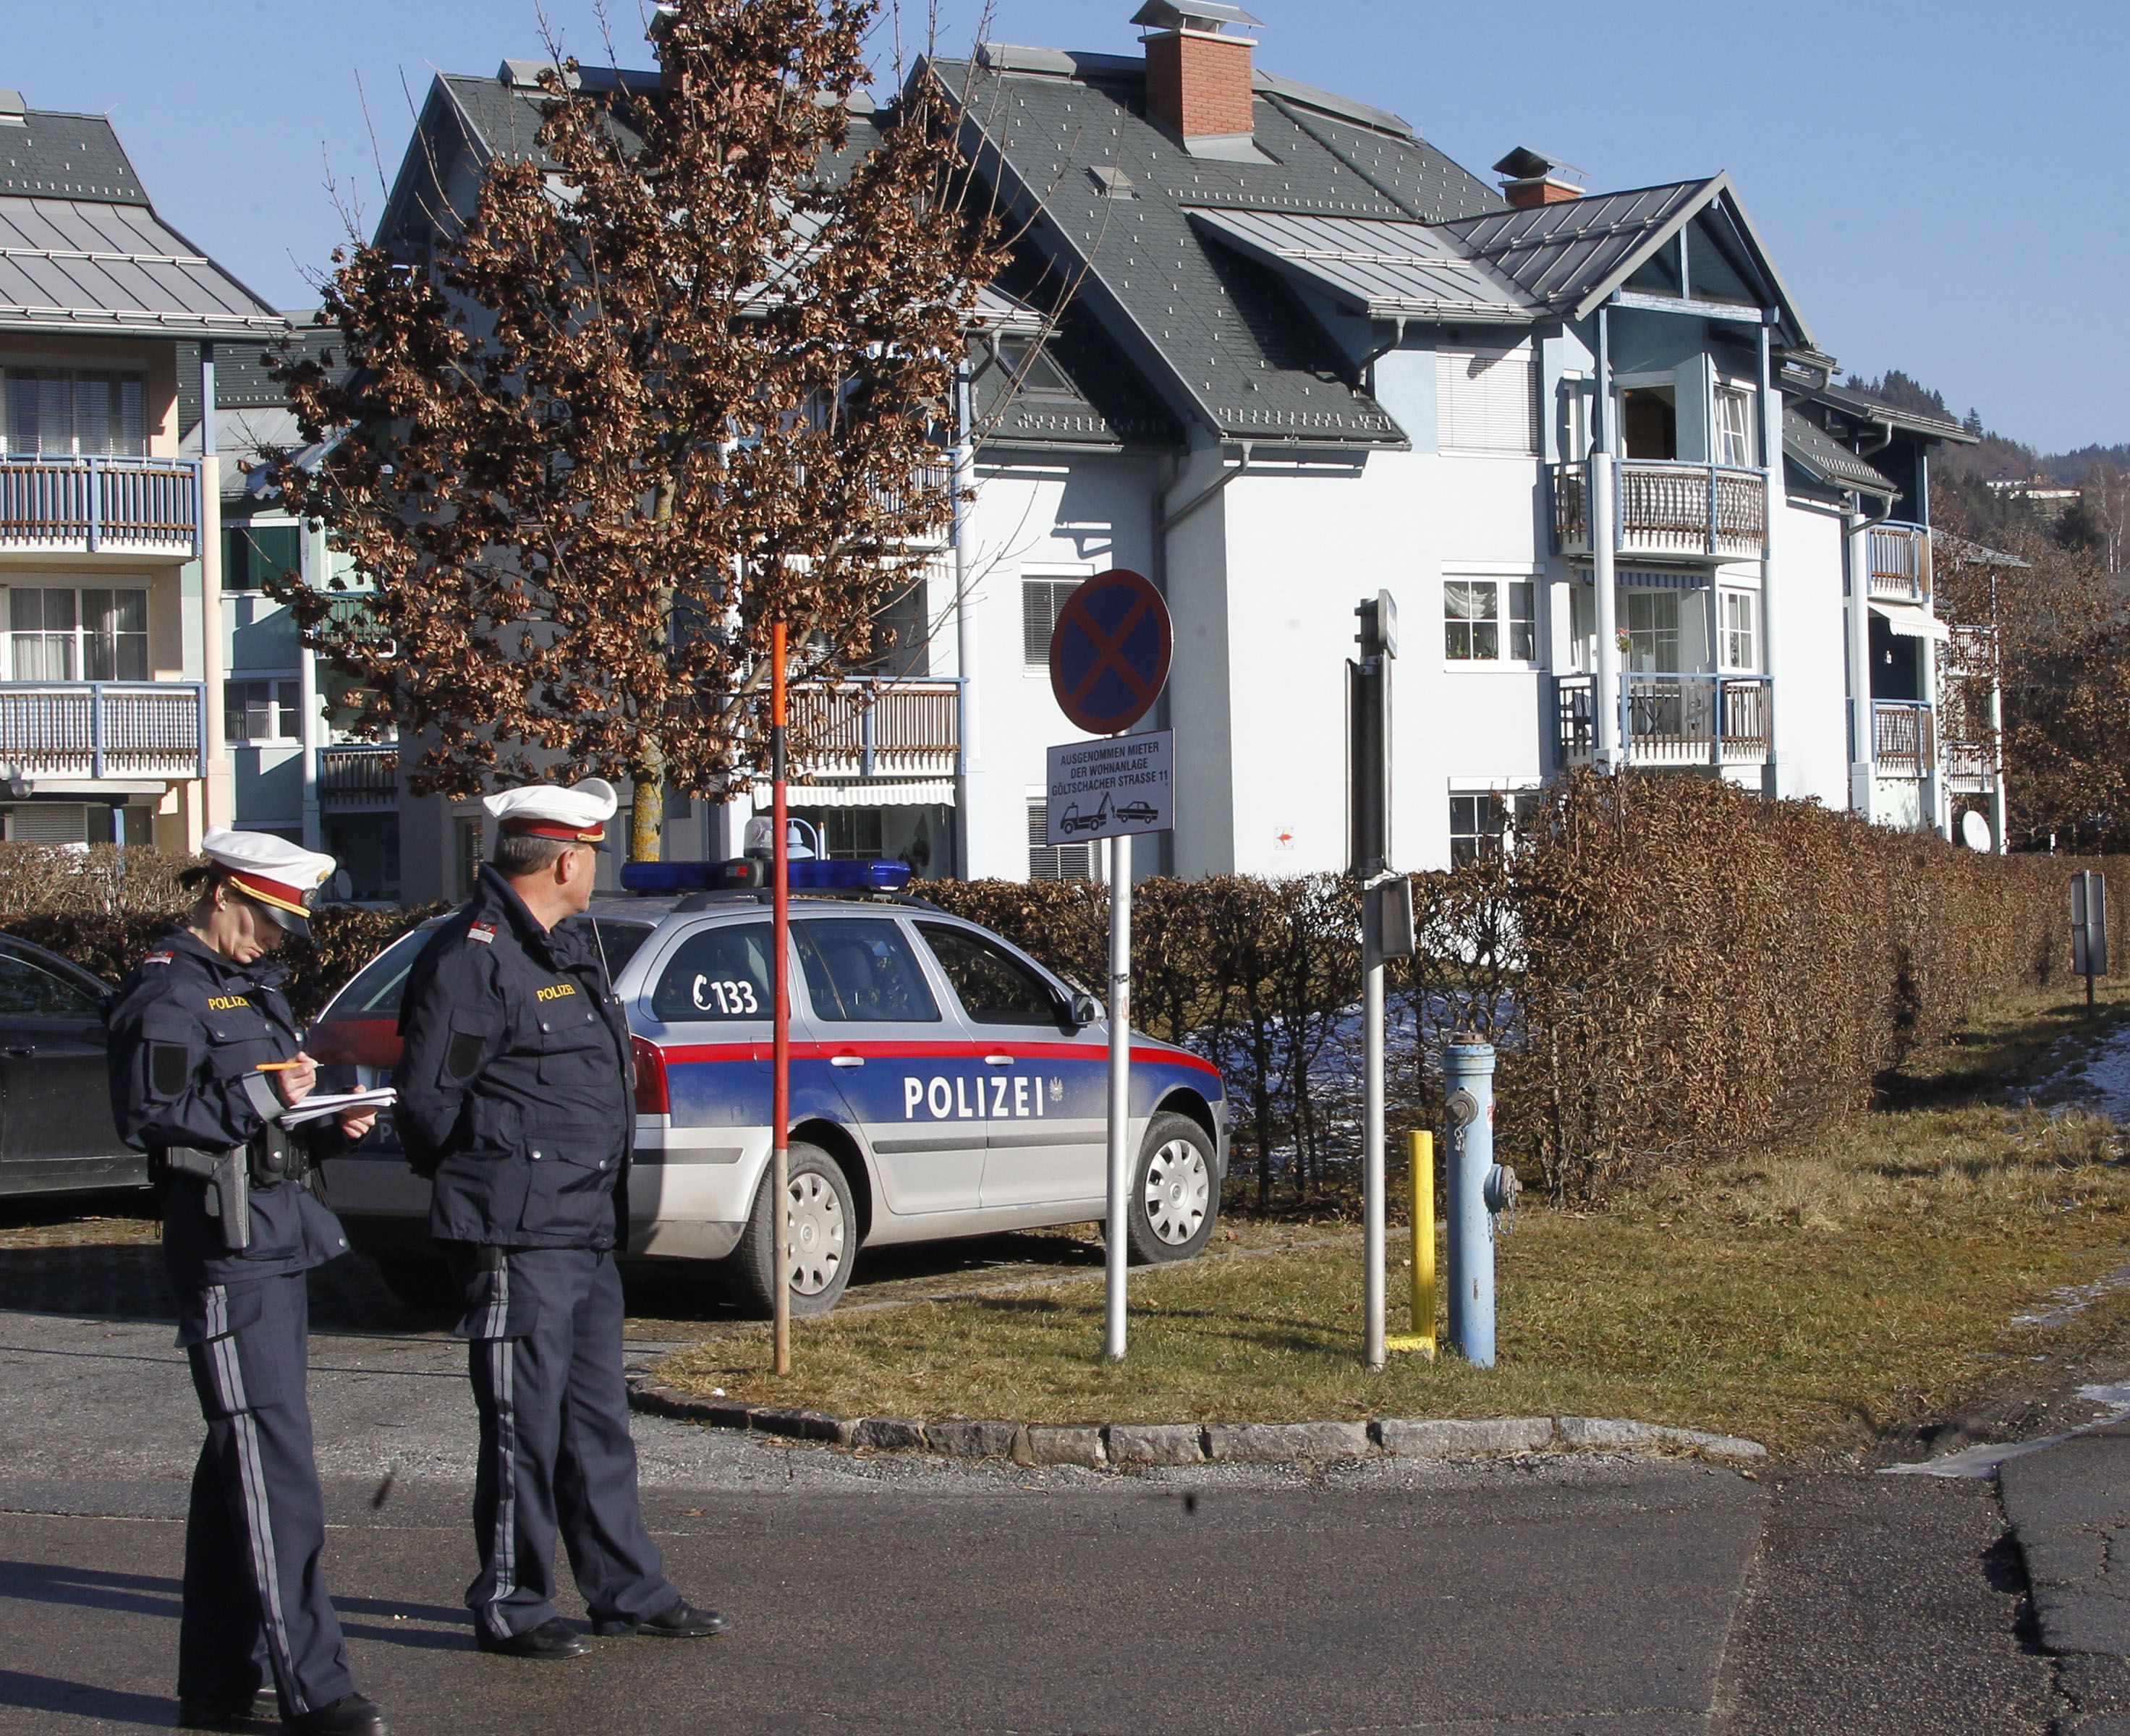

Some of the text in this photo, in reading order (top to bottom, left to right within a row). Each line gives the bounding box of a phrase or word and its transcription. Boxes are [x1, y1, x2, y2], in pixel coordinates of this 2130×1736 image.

[1061, 741, 1159, 765] AUSGENOMMEN MIETER
[1071, 757, 1148, 779] DER WOHNANLAGE
[1052, 770, 1168, 796] GÖLTSCHACHER STRASSE 11
[710, 980, 758, 1014] 133
[904, 1076, 1043, 1118] POLIZEI
